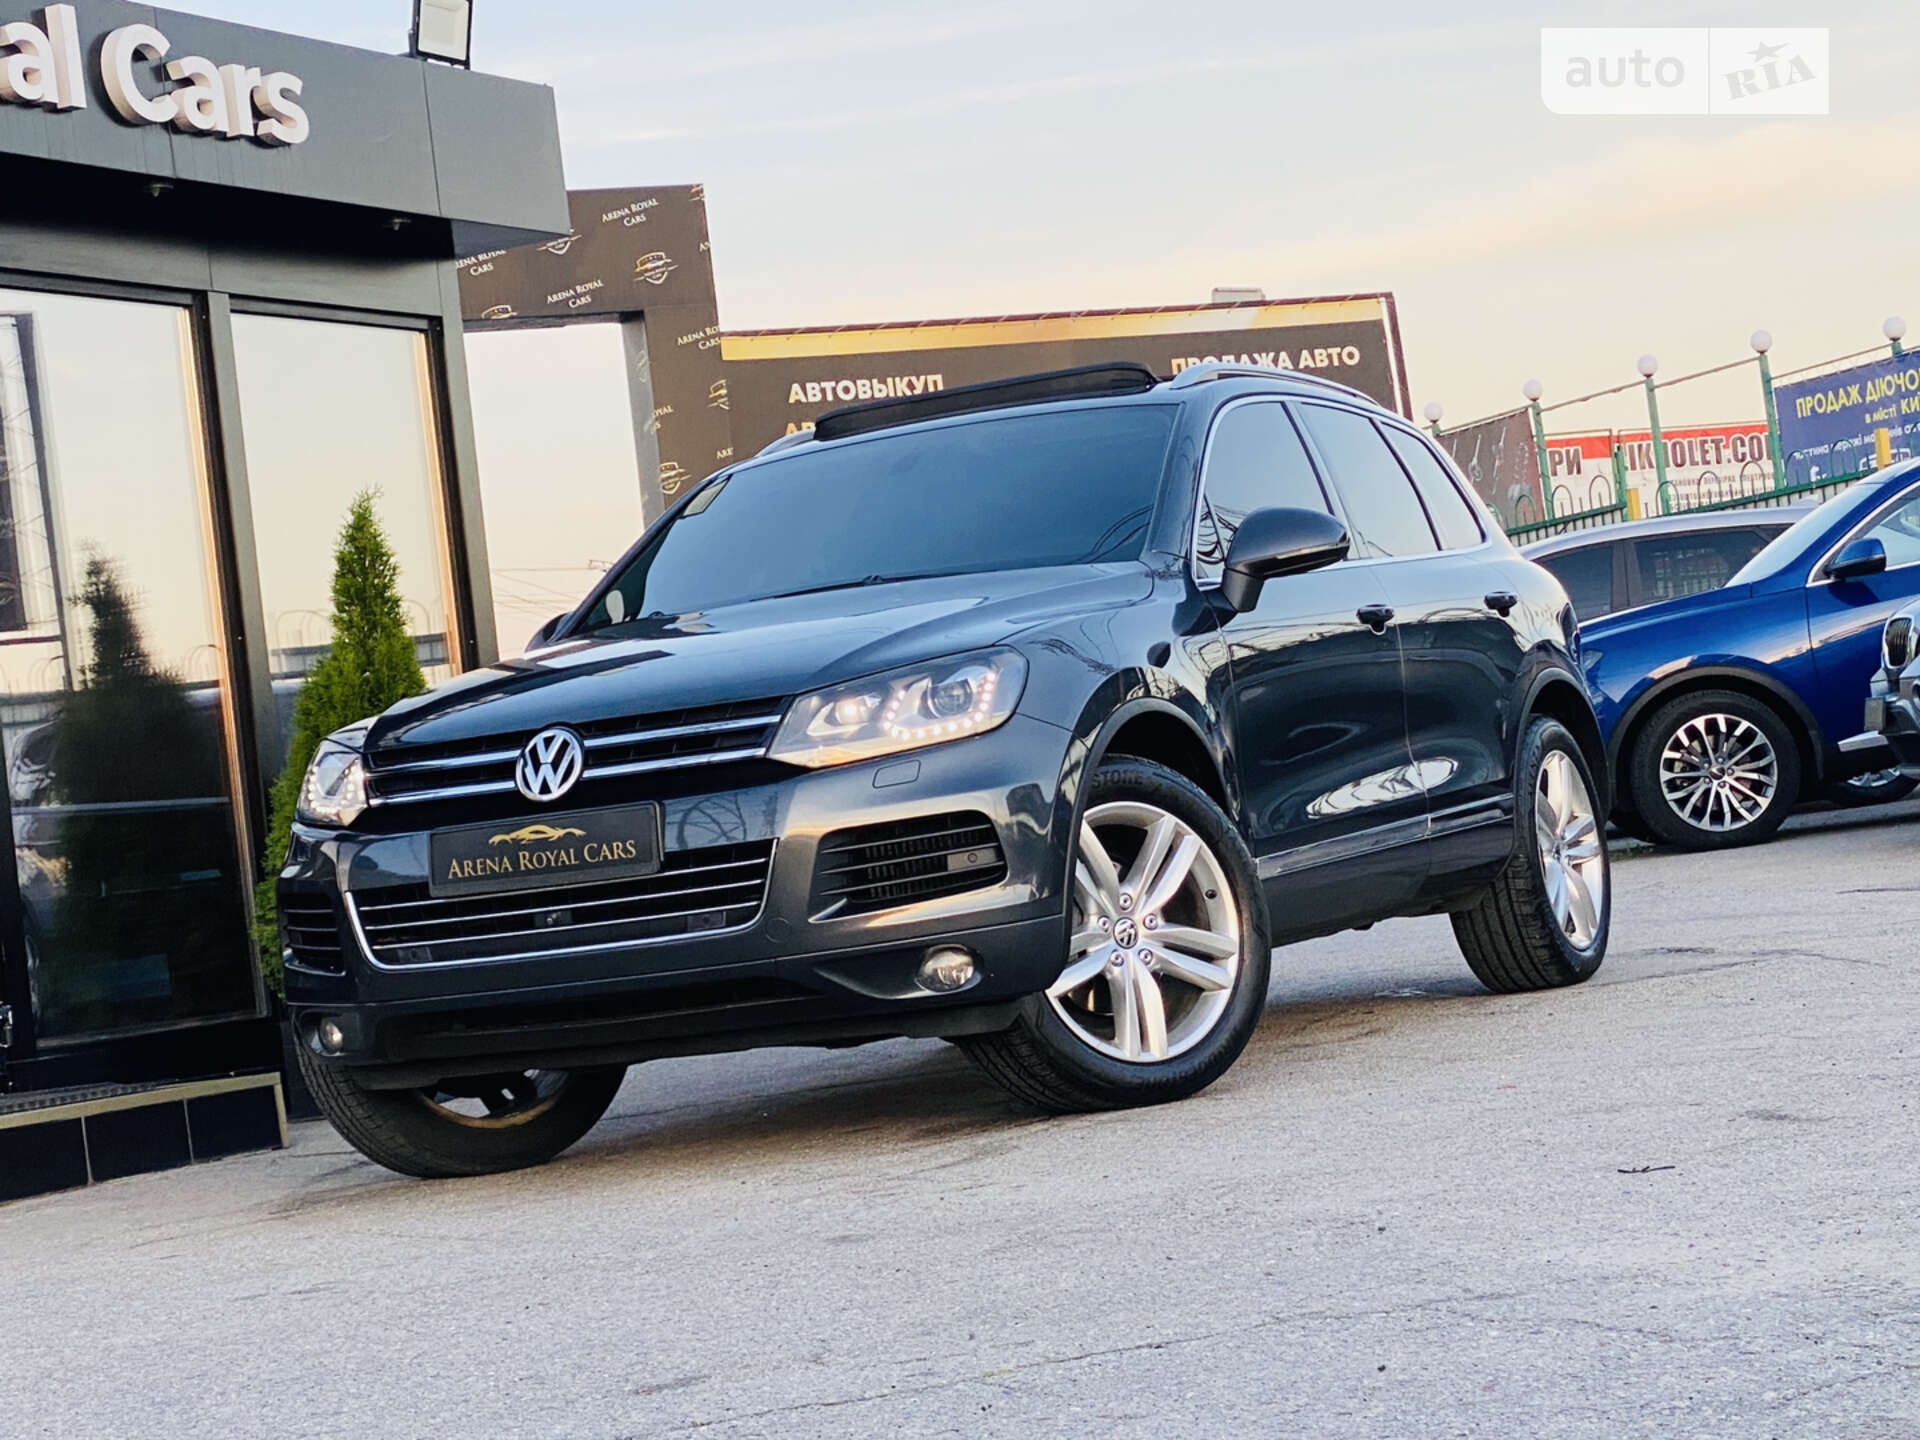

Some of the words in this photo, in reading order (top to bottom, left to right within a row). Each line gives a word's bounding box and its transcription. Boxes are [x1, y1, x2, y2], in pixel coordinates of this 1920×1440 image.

[0, 3, 87, 109] al
[100, 24, 310, 144] Cars
[602, 207, 631, 223] ARENA
[630, 198, 659, 213] ROYAL
[623, 213, 647, 227] CARS
[469, 262, 494, 276] CARS
[546, 288, 576, 304] ARENA
[575, 279, 604, 295] ROYAL
[568, 294, 592, 308] CARS
[677, 329, 705, 346] ARENA
[1298, 345, 1361, 369] АВТО
[788, 374, 945, 404] АВТОВЫКУП
[1795, 383, 1863, 419] ПРОДАЖ
[1865, 367, 1920, 404] ДІЮЧО
[1900, 391, 1920, 415] КИ
[448, 856, 512, 880] ARENA
[517, 847, 579, 872] ROYAL
[583, 839, 637, 864] CARS
